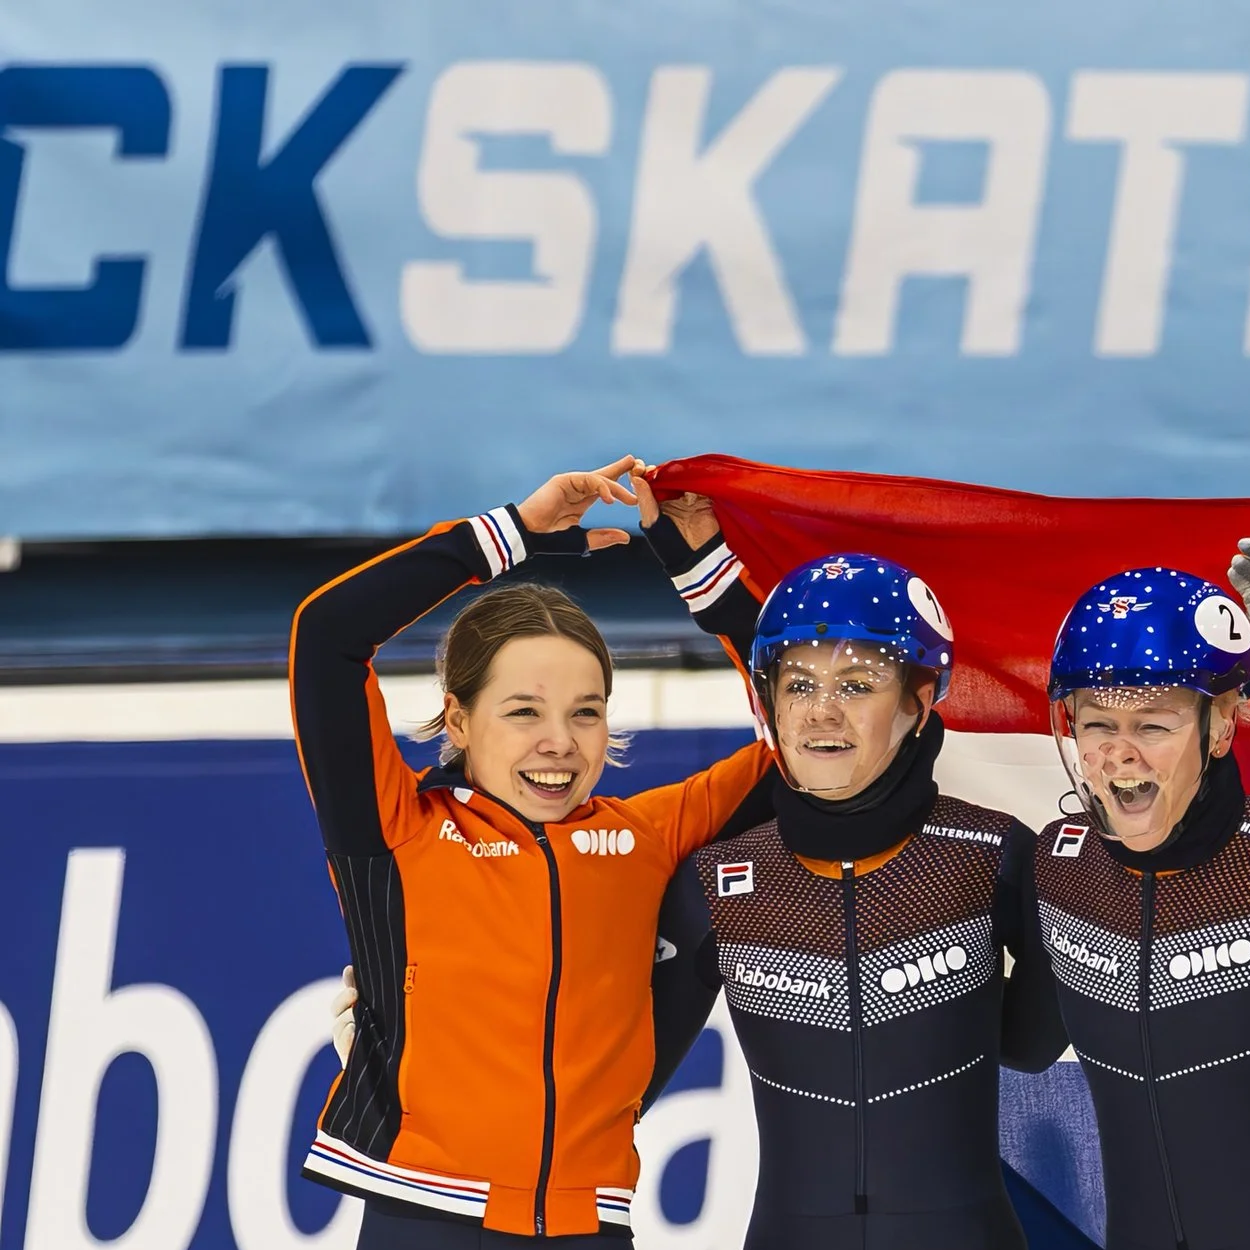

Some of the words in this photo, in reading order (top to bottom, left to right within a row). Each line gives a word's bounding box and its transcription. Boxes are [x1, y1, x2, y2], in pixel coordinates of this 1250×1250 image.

[1218, 604, 1242, 640] 2
[922, 823, 1003, 847] HILTERMANN
[1050, 925, 1122, 978] Rabobank
[734, 963, 834, 1000] Rabobank
